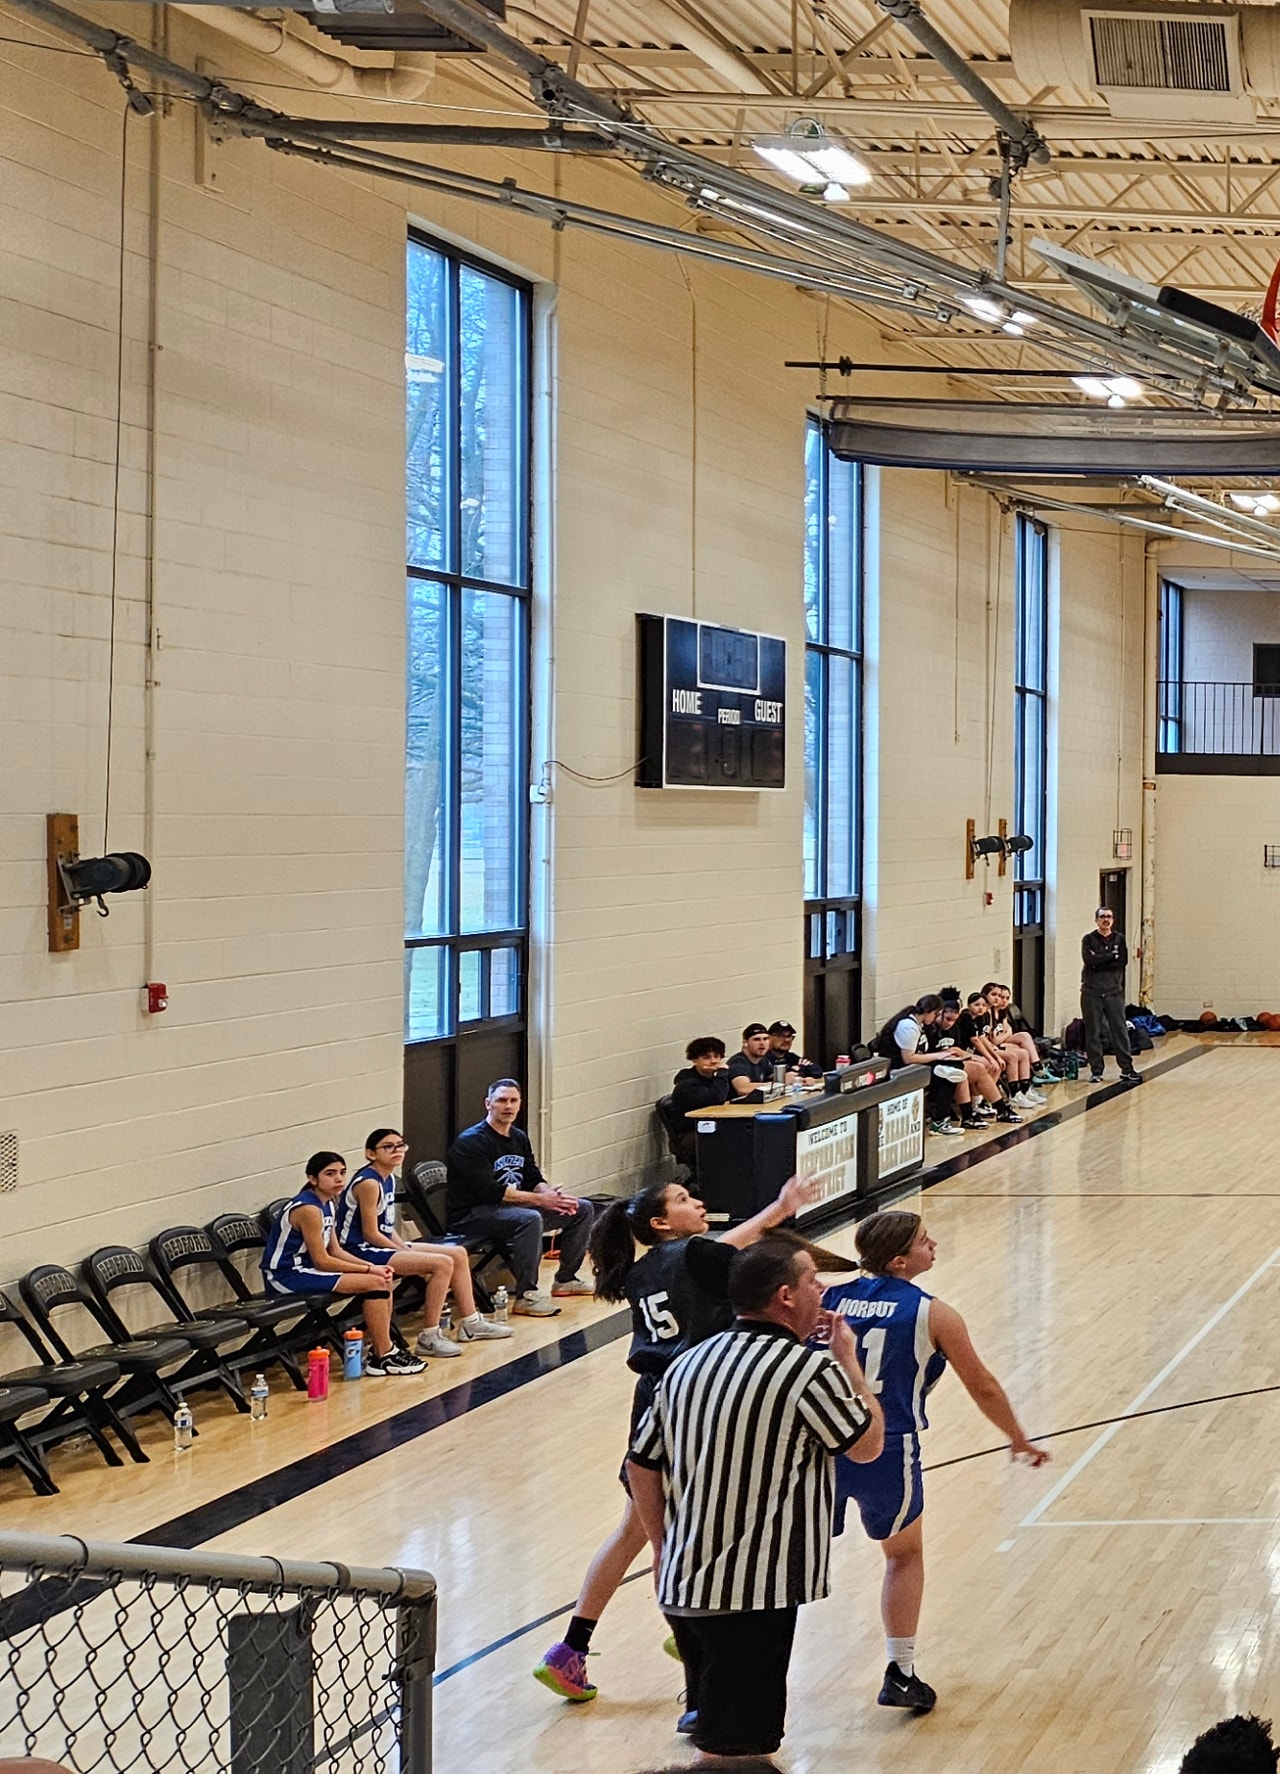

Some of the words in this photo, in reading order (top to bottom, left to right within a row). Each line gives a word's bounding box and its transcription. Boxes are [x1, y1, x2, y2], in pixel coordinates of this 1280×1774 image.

[672, 689, 702, 714] HOME
[754, 699, 783, 723] GUEST
[717, 708, 741, 725] PERIOD
[163, 1233, 212, 1261] BEDFORD
[97, 1253, 144, 1283] BEDFORD
[34, 1272, 77, 1303] BEDFORD
[639, 1291, 679, 1343] 15
[836, 1298, 898, 1319] NORBUT
